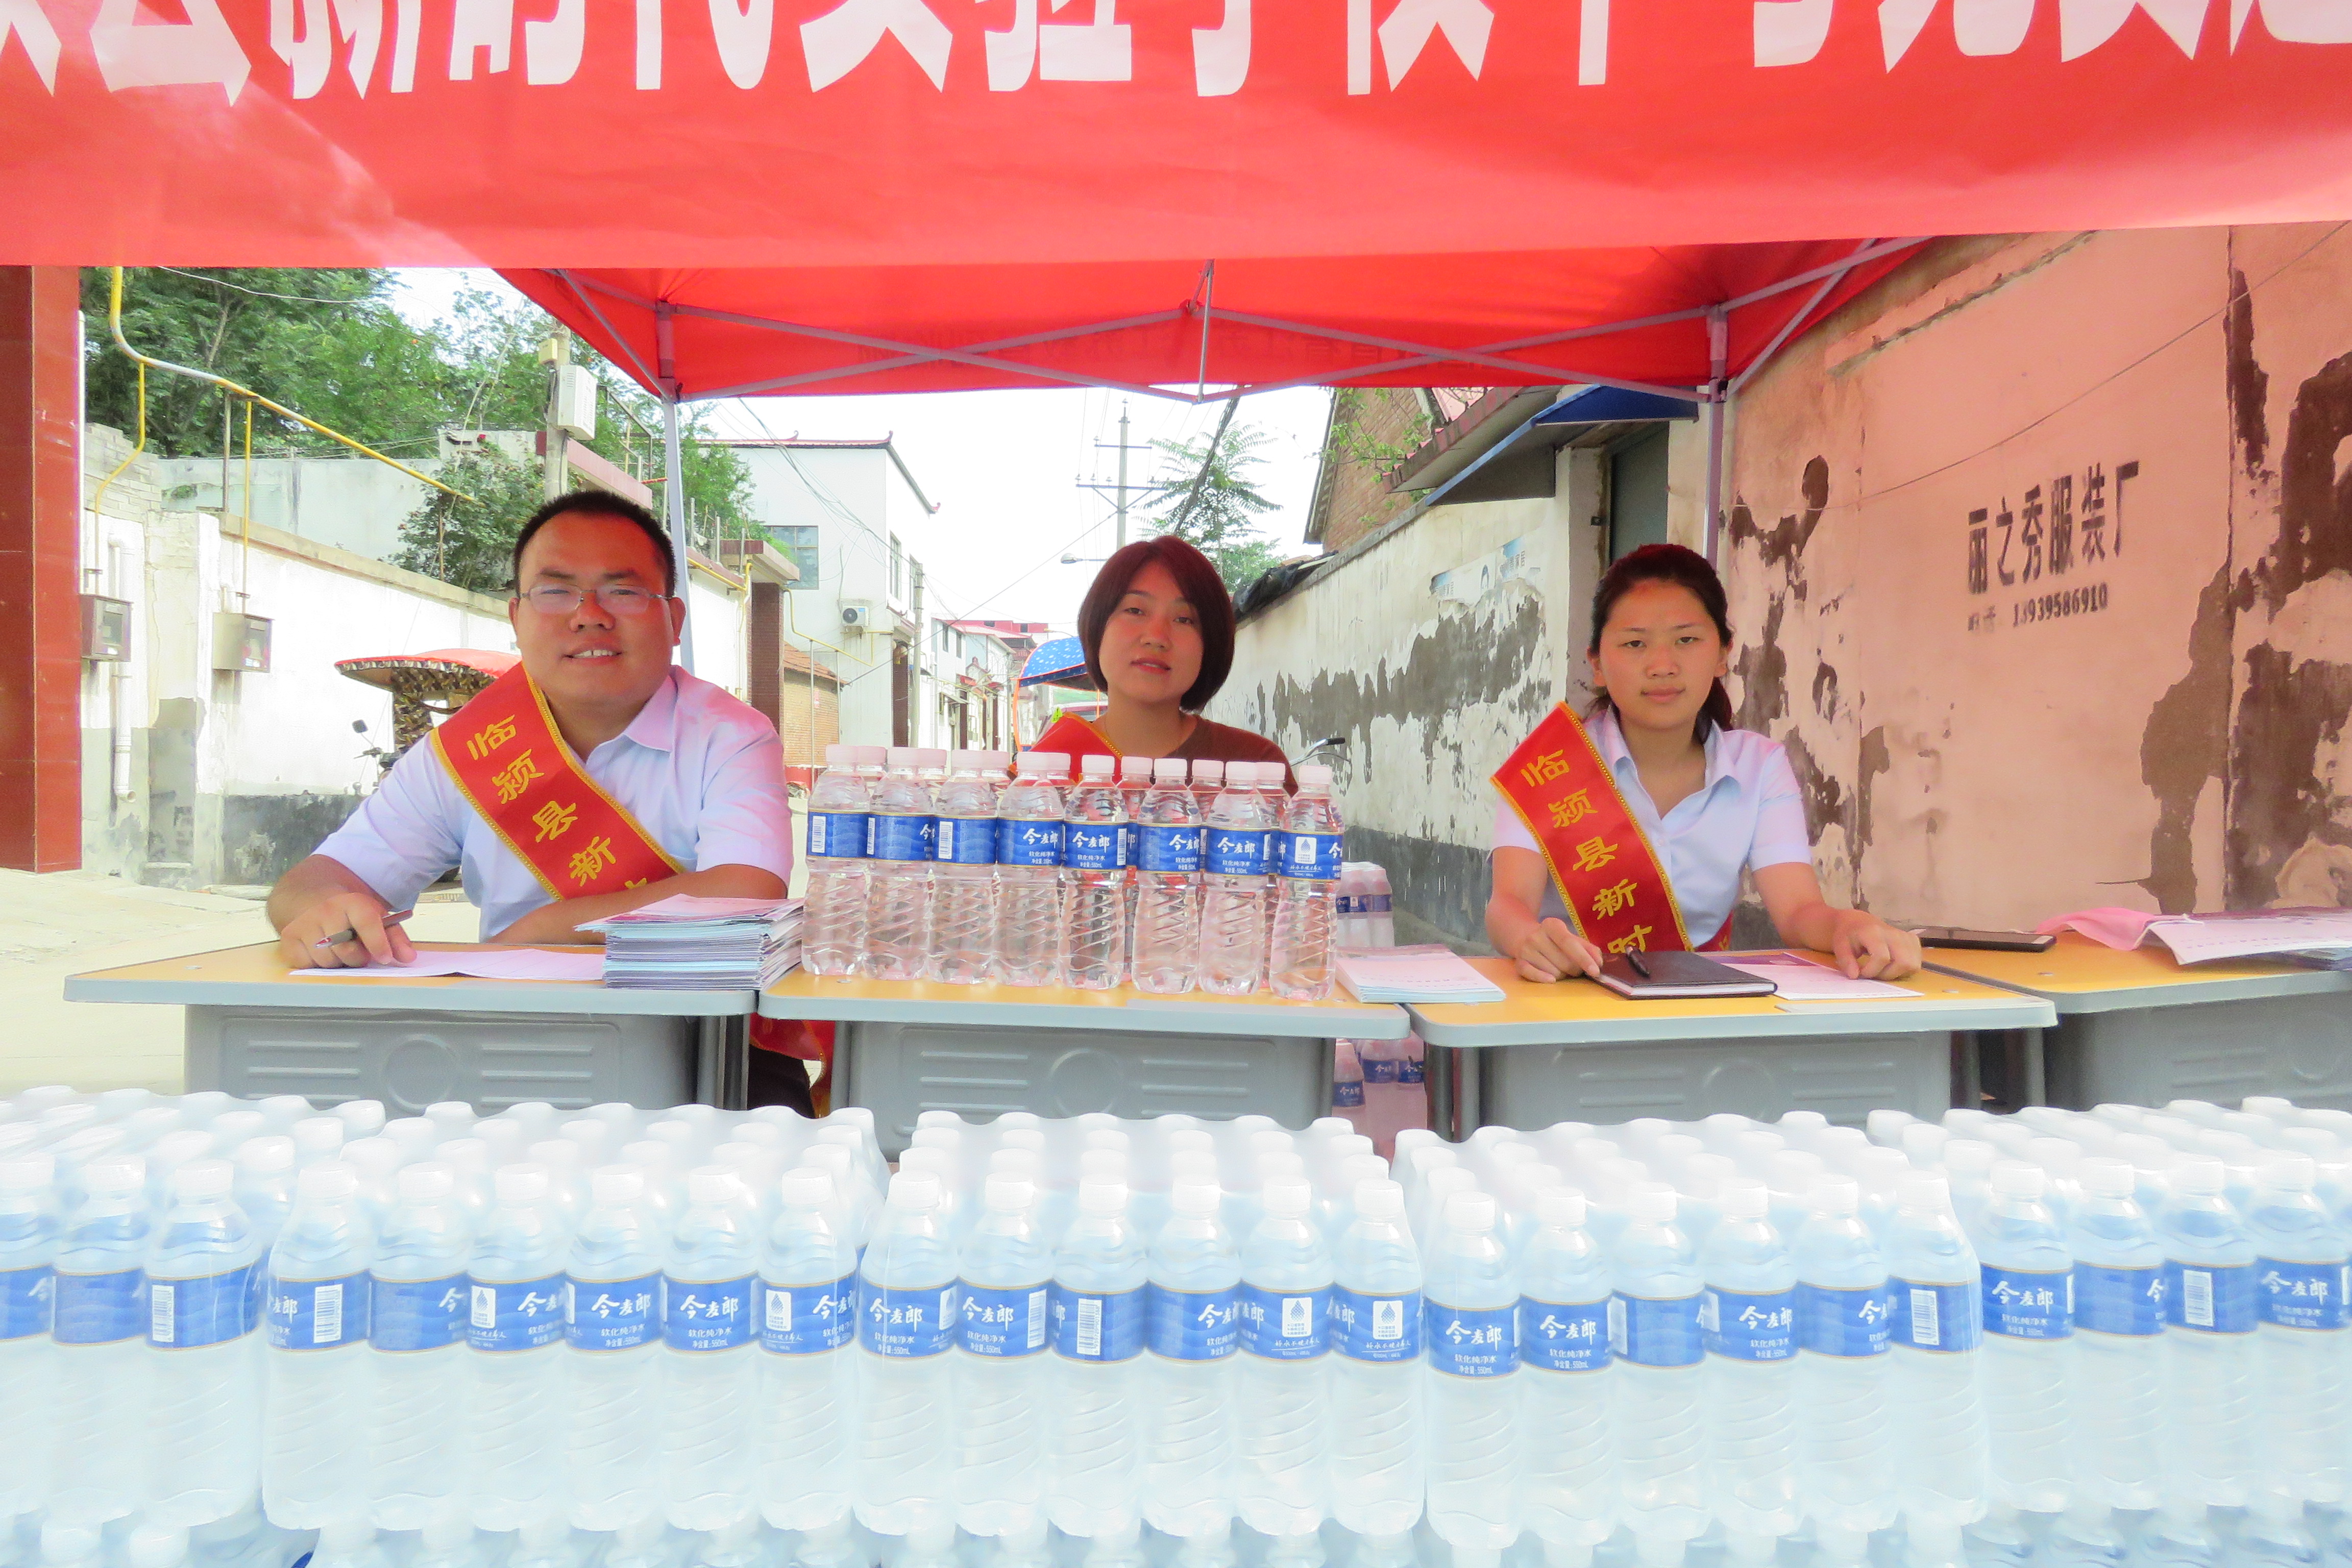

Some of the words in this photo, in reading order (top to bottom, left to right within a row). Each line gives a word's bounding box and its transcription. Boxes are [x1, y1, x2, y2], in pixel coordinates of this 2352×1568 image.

[1968, 461, 2140, 595] 丽之秀服装厂
[1023, 828, 1058, 848] 今麦郎
[1072, 831, 1110, 853] 今麦郎
[1217, 837, 1256, 859] 今麦郎
[1992, 1281, 2053, 1315] 今麦郎
[2261, 1270, 2328, 1306] 今麦郎
[592, 1293, 651, 1319] 今麦郎
[680, 1294, 739, 1322] 今麦郎
[870, 1297, 923, 1332] 今麦郎
[963, 1296, 1014, 1331] 今麦郎
[1738, 1306, 1793, 1332] 今麦郎
[600, 1324, 645, 1337] 软化纯净水
[688, 1327, 732, 1338] 软化纯净水
[874, 1332, 915, 1344] 软化纯净水
[967, 1331, 1006, 1344] 软化纯净水
[1446, 1320, 1502, 1351] 今麦郎
[1540, 1315, 1597, 1345] 今麦郎
[1455, 1354, 1497, 1364] 软化纯净水
[1550, 1348, 1591, 1358] 软化纯净水
